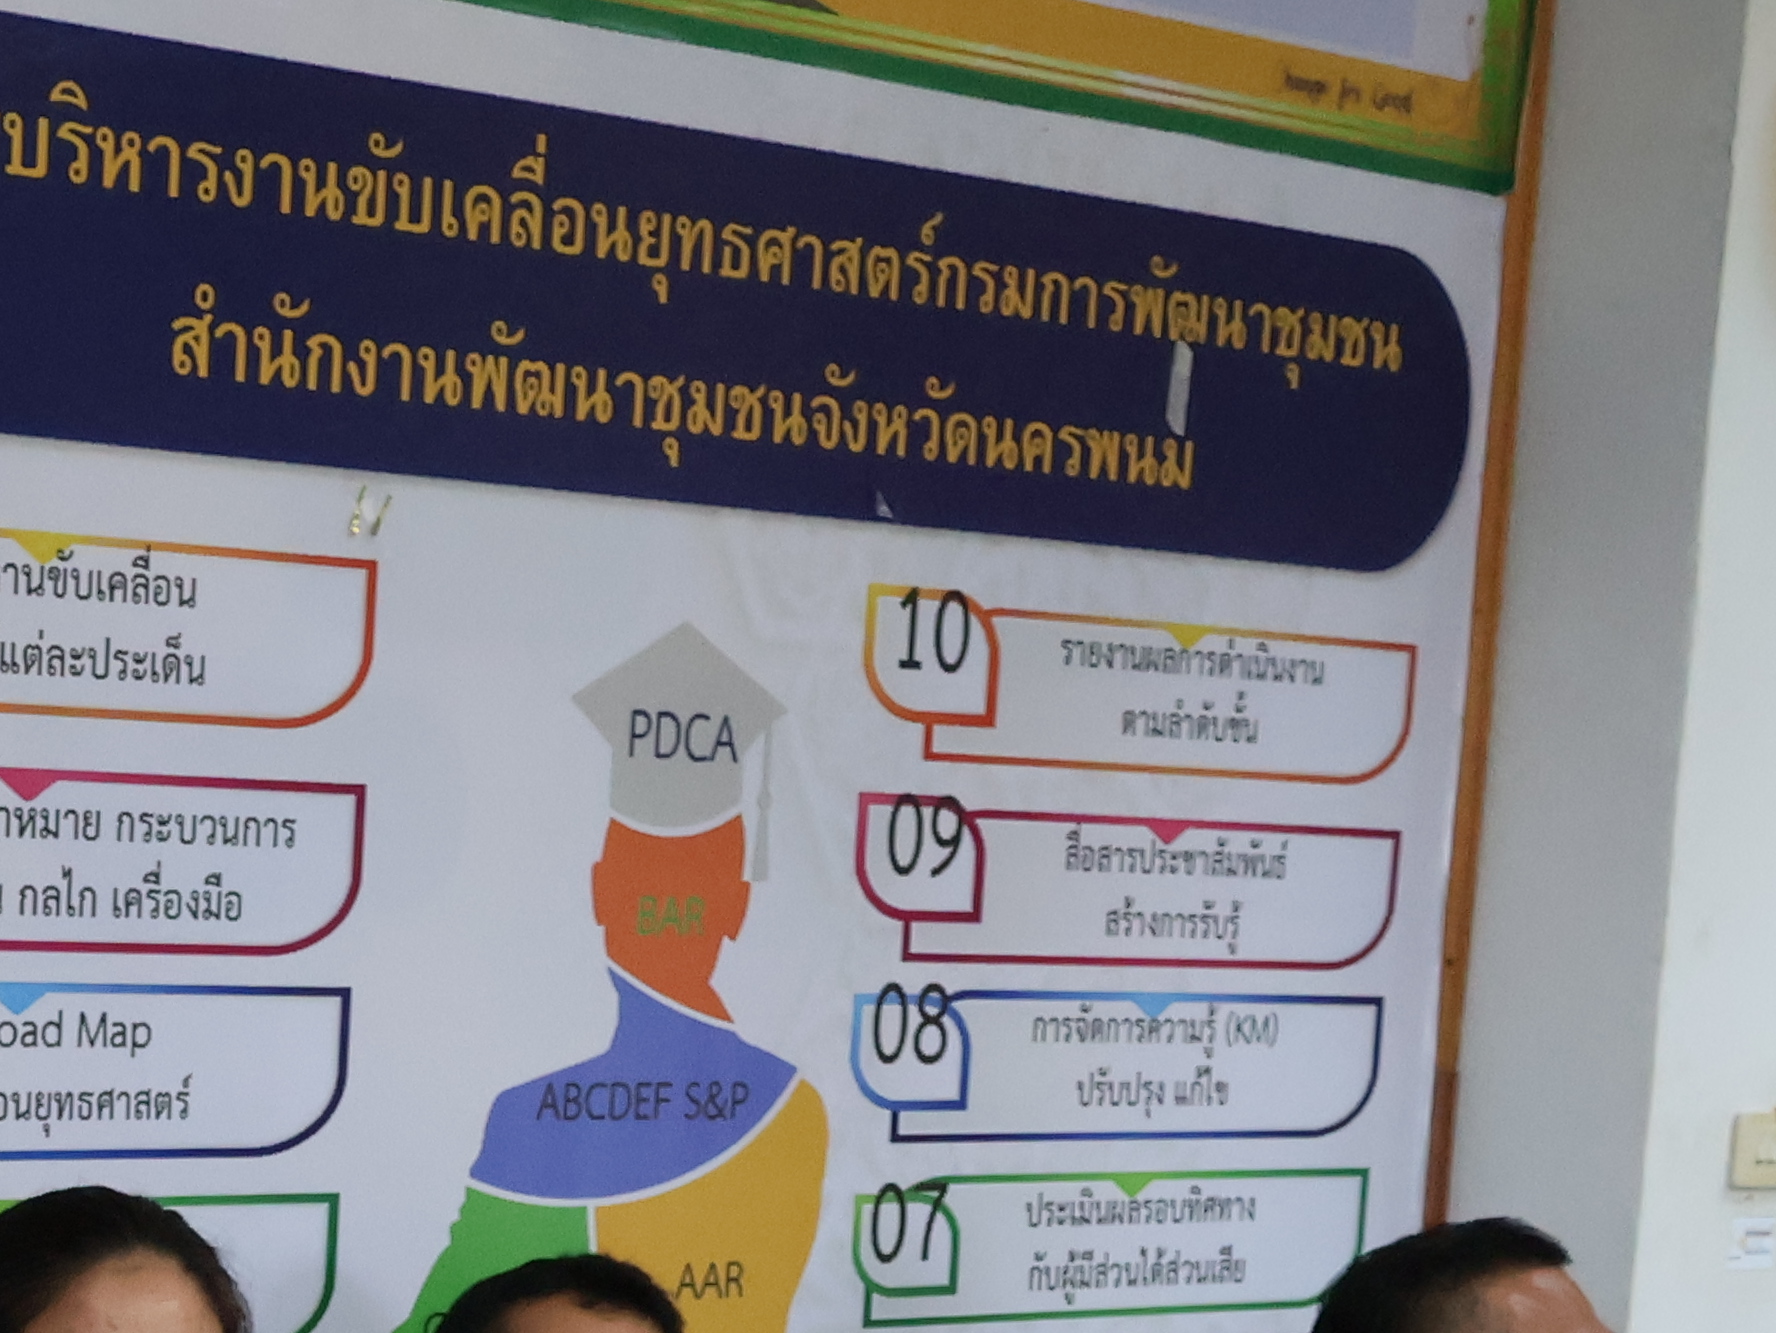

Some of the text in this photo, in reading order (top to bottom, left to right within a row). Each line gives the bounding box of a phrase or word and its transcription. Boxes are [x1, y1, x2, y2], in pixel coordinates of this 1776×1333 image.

[171, 283, 1194, 491] สำนักงานพัฒนาชุมชนจังหวัดนครพนม
[898, 587, 971, 674] 10
[629, 710, 739, 764] PDCA
[116, 809, 296, 850] กระบวนการ
[888, 793, 964, 879] 09
[18, 866, 99, 920] กลไก
[110, 860, 243, 923] เครื่องมือ
[637, 895, 706, 936] BAR
[77, 1012, 153, 1058] Map
[873, 982, 947, 1065] 08
[1225, 1011, 1280, 1050] (KM)
[536, 1082, 749, 1122] ABCDEF S&P
[1174, 1065, 1229, 1107] แก้ไข
[871, 1182, 948, 1263] 07
[676, 1261, 745, 1299] AAR
